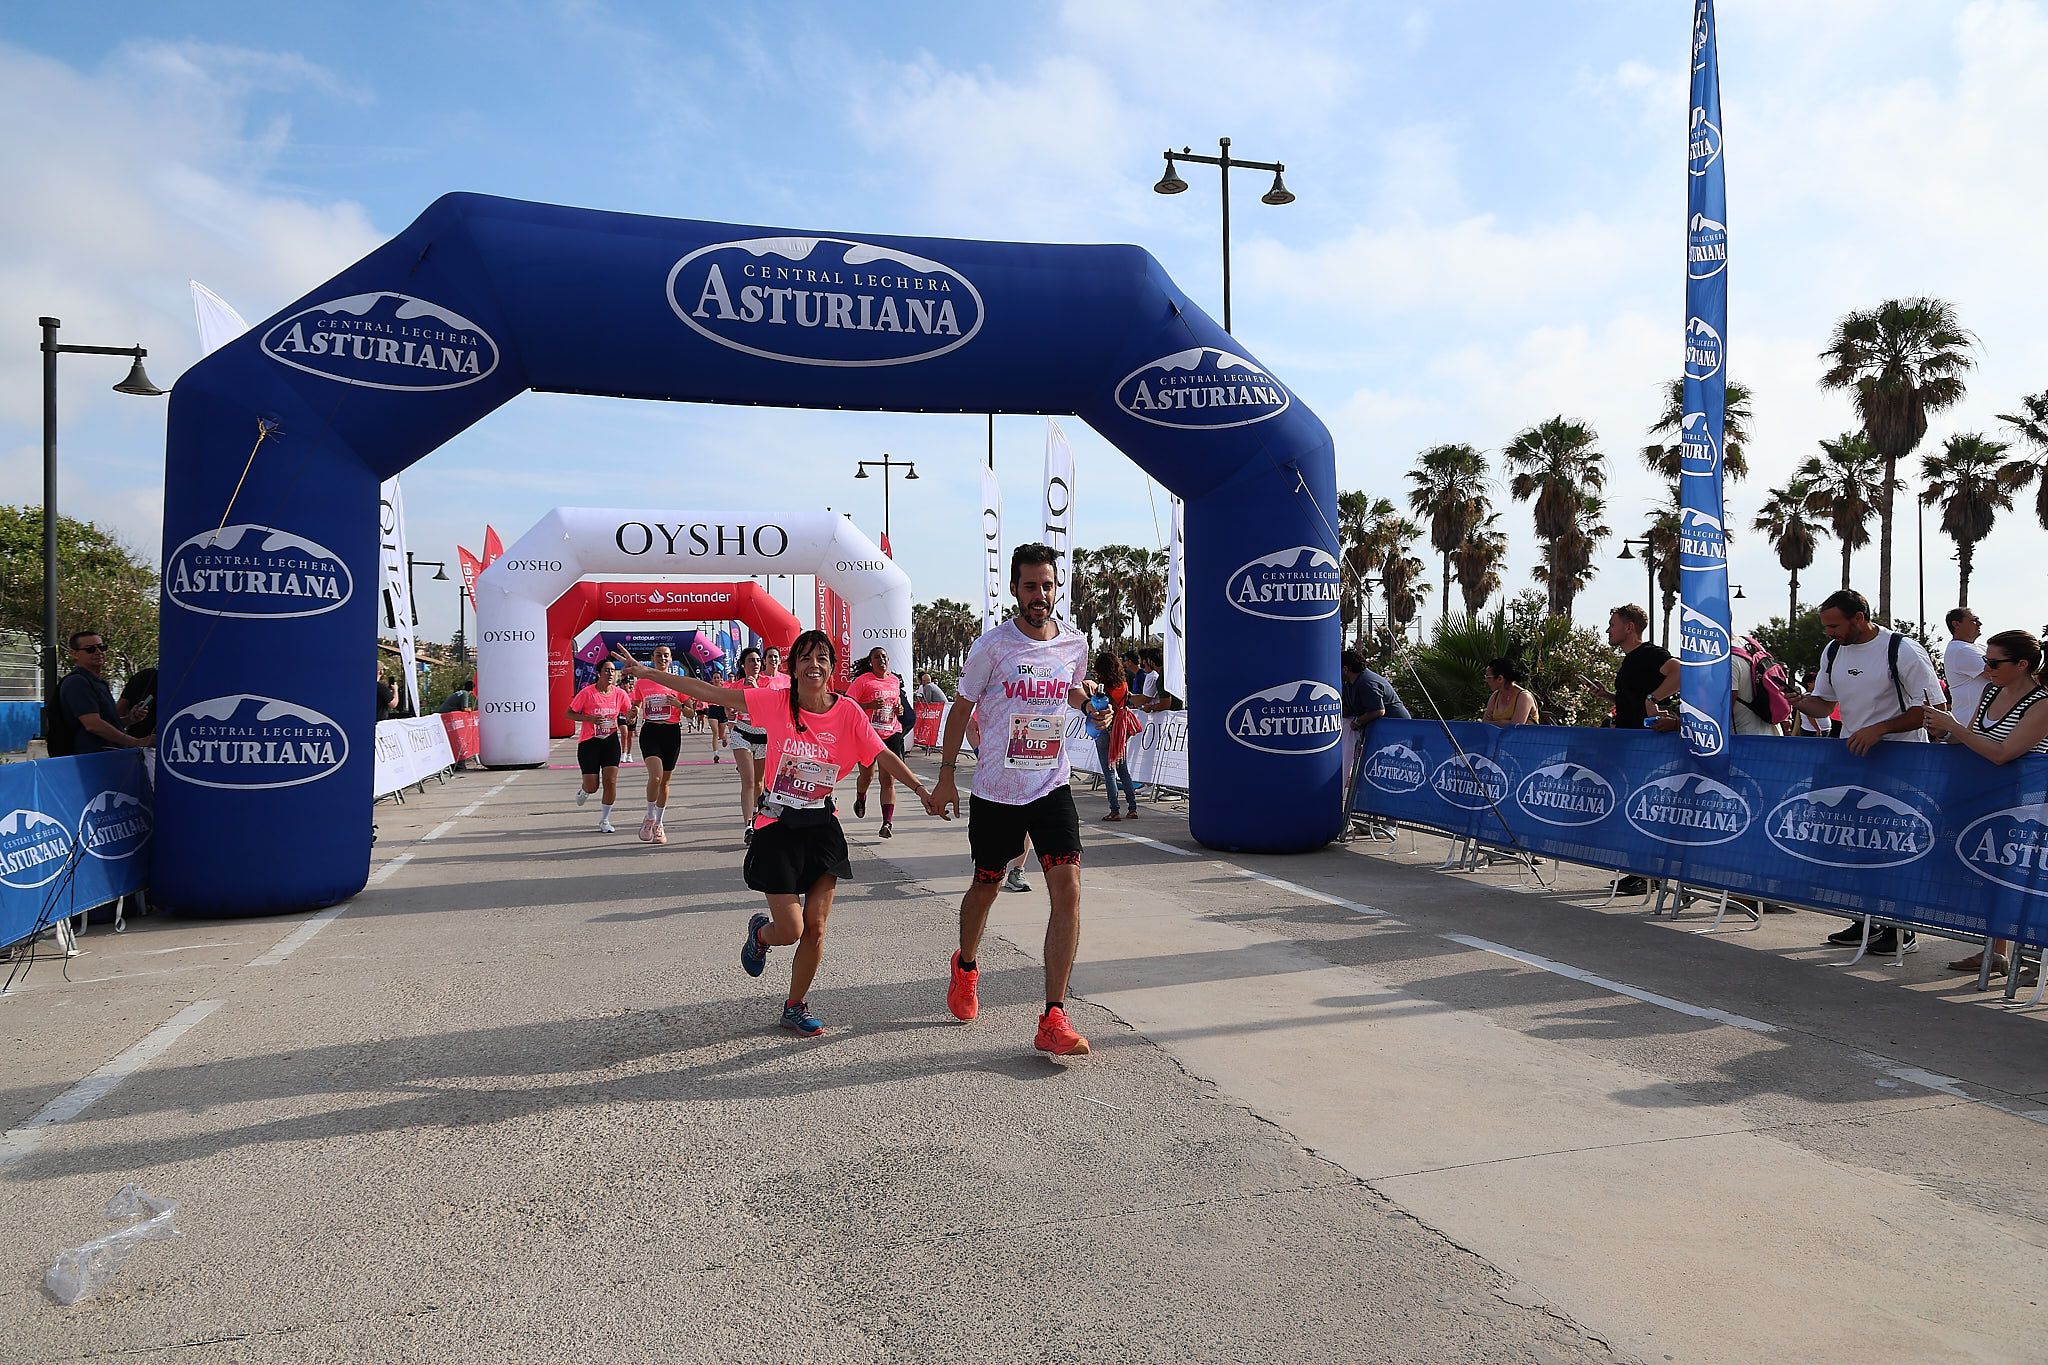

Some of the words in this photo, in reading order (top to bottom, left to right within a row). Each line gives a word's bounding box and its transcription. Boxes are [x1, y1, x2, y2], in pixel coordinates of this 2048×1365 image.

[743, 264, 845, 285] CENTRAL
[854, 273, 951, 292] LECHERA
[692, 263, 961, 335] ASTURIANA
[317, 319, 394, 334] CENTRAL
[402, 326, 477, 346] LECHERA
[274, 322, 480, 374] ASTURIANA
[1160, 374, 1219, 386] CENTRAL
[1223, 374, 1270, 385] LECHERA
[1130, 380, 1283, 410] ASTURIANA
[615, 521, 789, 558] OYSHO
[195, 555, 260, 566] CENTRAL
[268, 558, 336, 572] LECHERA
[507, 560, 562, 572] OYSHO
[836, 560, 884, 572] OYSHO
[172, 558, 341, 600] ASTURIANA
[1262, 571, 1310, 580] CENTRAL
[605, 591, 647, 606] Sports
[666, 591, 731, 603] Santander
[483, 630, 535, 643] OYSHO
[862, 628, 907, 639] OYSHO
[1017, 664, 1033, 674] 15K
[485, 701, 536, 714] OYSHO
[1261, 705, 1310, 714] CENTRAL
[190, 725, 256, 737] CENTRAL
[263, 727, 331, 738] LECHERA
[168, 727, 337, 764] ASTURIANA
[1026, 739, 1048, 749] 016
[793, 779, 816, 792] 016
[1521, 781, 1605, 814] ASTURIANA
[1632, 794, 1738, 832] ASTURIANA
[1803, 809, 1854, 822] CENTRAL
[1859, 815, 1917, 828] LECHERA
[1774, 809, 1918, 853] ASTURIANA
